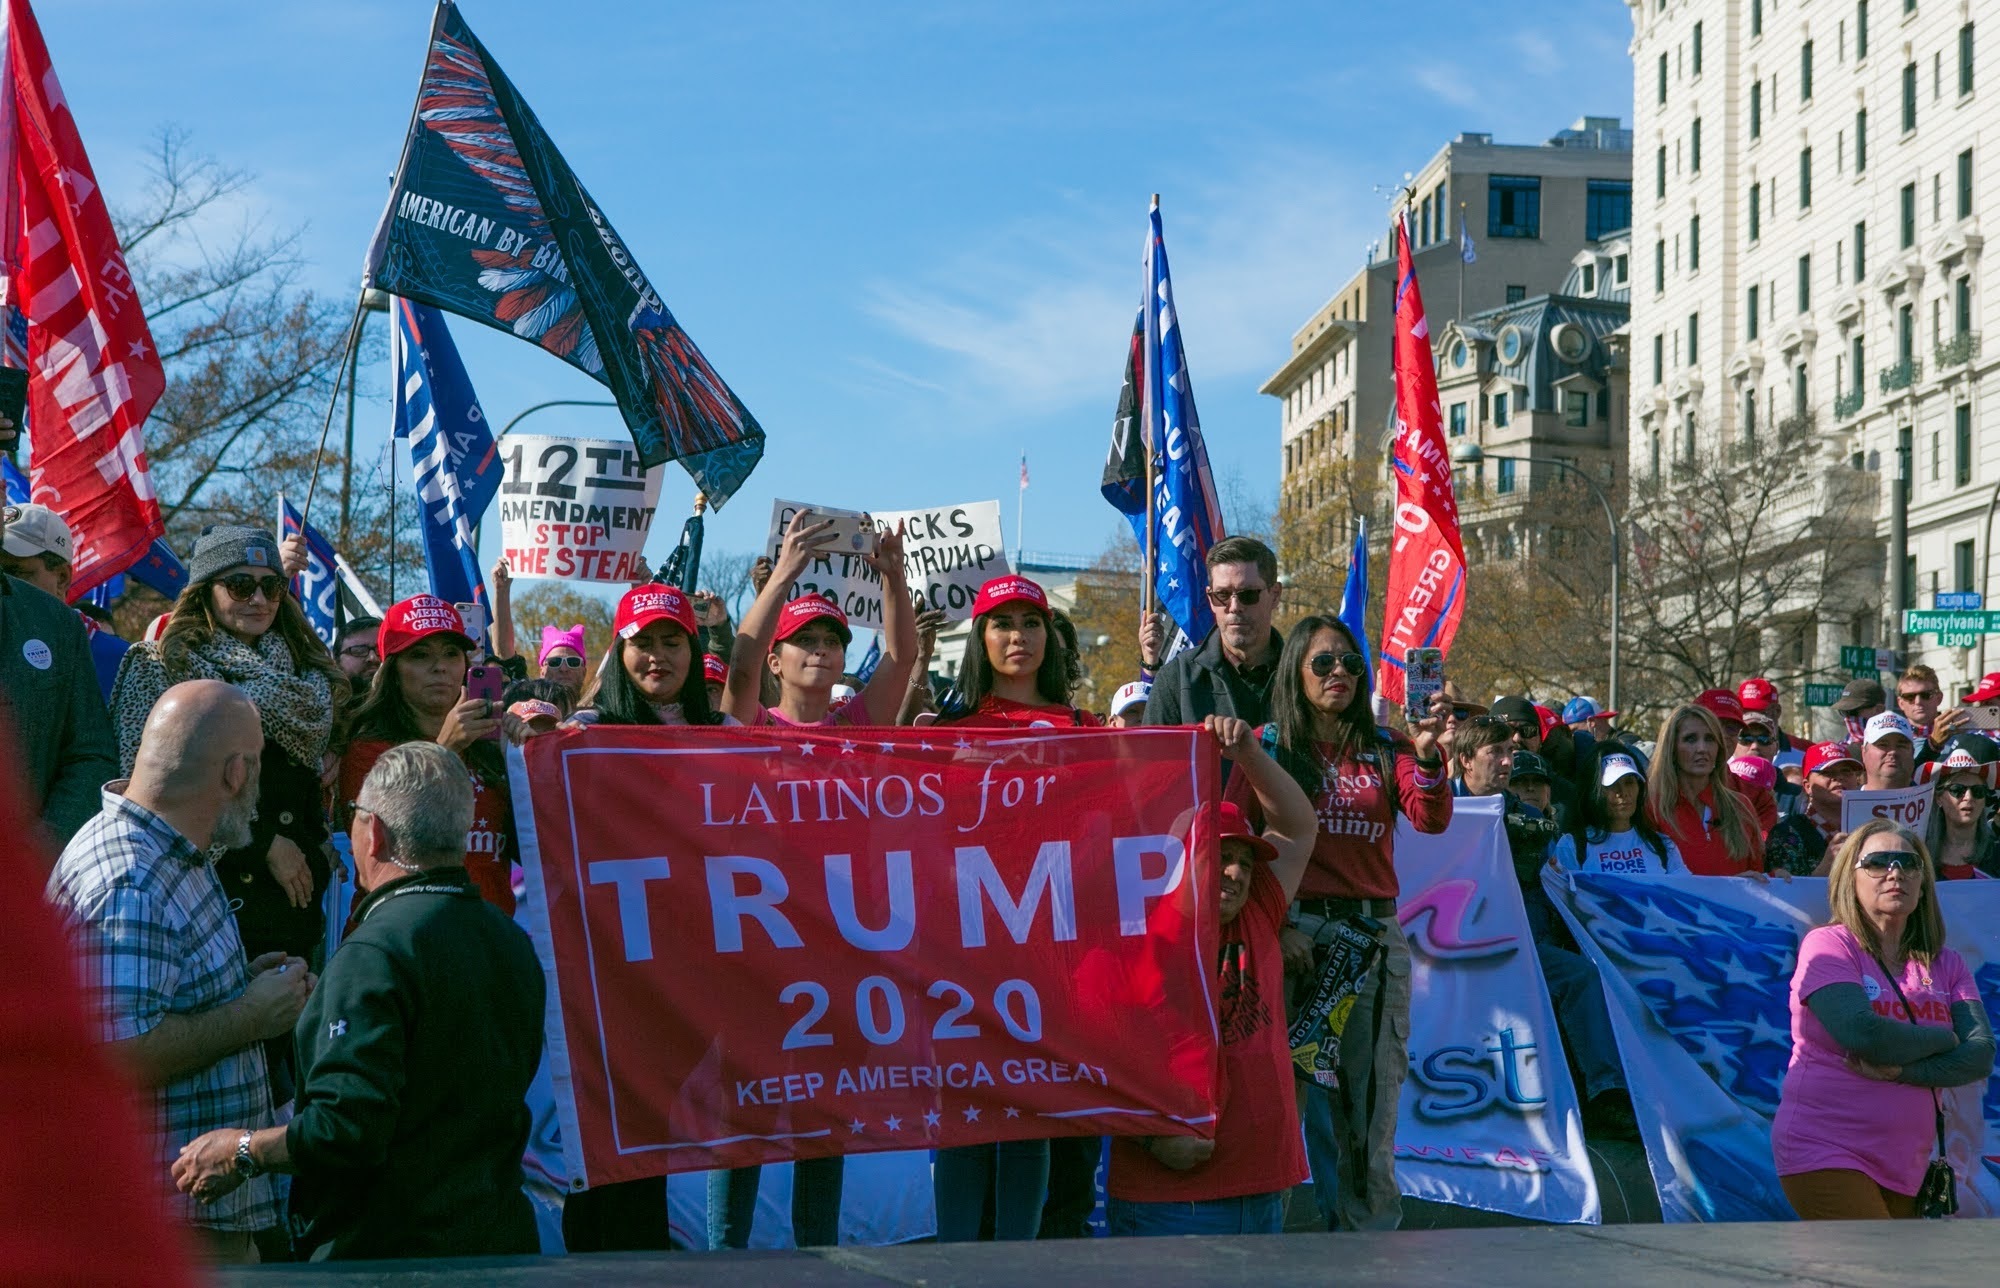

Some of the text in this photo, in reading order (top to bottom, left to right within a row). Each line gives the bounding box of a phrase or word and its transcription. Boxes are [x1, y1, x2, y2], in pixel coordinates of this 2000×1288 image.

[398, 191, 496, 244] AMERICAN
[495, 226, 532, 259] BY
[503, 444, 646, 499] 12TH
[502, 500, 656, 540] AMENDMENT
[55, 535, 66, 548] 45
[535, 524, 604, 547] STOP
[506, 548, 641, 581] THE STEAL
[911, 544, 995, 577] TRUMP
[988, 581, 1041, 595] MAKE AMERICA
[990, 587, 1040, 599] GREAT AGAIN
[411, 597, 444, 608] KEEP
[631, 593, 680, 605] Trump
[402, 608, 457, 624] AMERICA
[788, 602, 841, 617] MAKE AMERICA
[793, 607, 818, 616] GREAT
[412, 618, 453, 631] GREAT
[1910, 614, 1985, 632] Pennsylvania
[1943, 633, 1973, 646] 1300
[1846, 649, 1857, 666] 14
[1808, 687, 1824, 703] RON
[1873, 718, 1908, 729] AMERICA
[1603, 756, 1632, 765] Trump
[701, 760, 1056, 832] LATINOS for
[1325, 793, 1355, 811] for
[1872, 799, 1925, 823] STOP
[1599, 848, 1642, 862] FOUR
[1601, 858, 1646, 872] MORE
[395, 885, 425, 896] Security
[588, 834, 1187, 962] TRUMP
[1289, 943, 1349, 1048] INFOWARS.COM
[778, 976, 1042, 1051] 2020
[736, 1058, 1109, 1107] KEEP AMERICA GREAT
